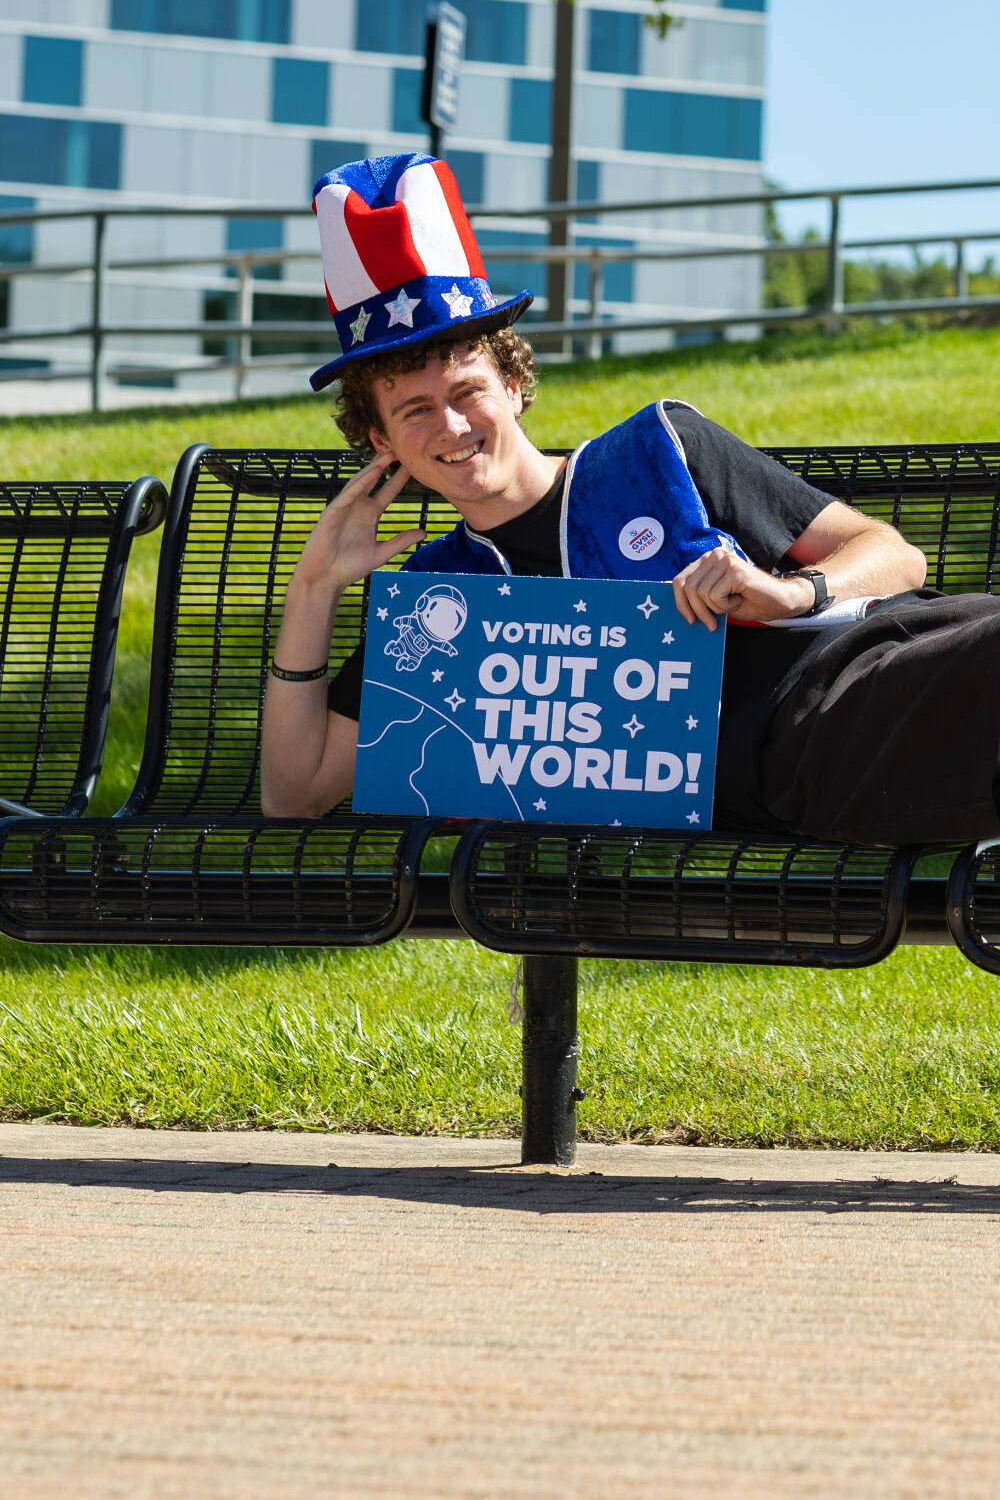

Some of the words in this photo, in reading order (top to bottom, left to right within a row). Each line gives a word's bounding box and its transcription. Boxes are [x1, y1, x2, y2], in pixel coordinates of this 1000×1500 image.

[632, 530, 653, 550] GVSU
[481, 621, 592, 647] VOTING
[599, 625, 627, 647] IS
[478, 652, 598, 698] OUT
[613, 658, 692, 702] OF
[475, 697, 602, 744] THIS
[471, 742, 702, 794] WORLD!
